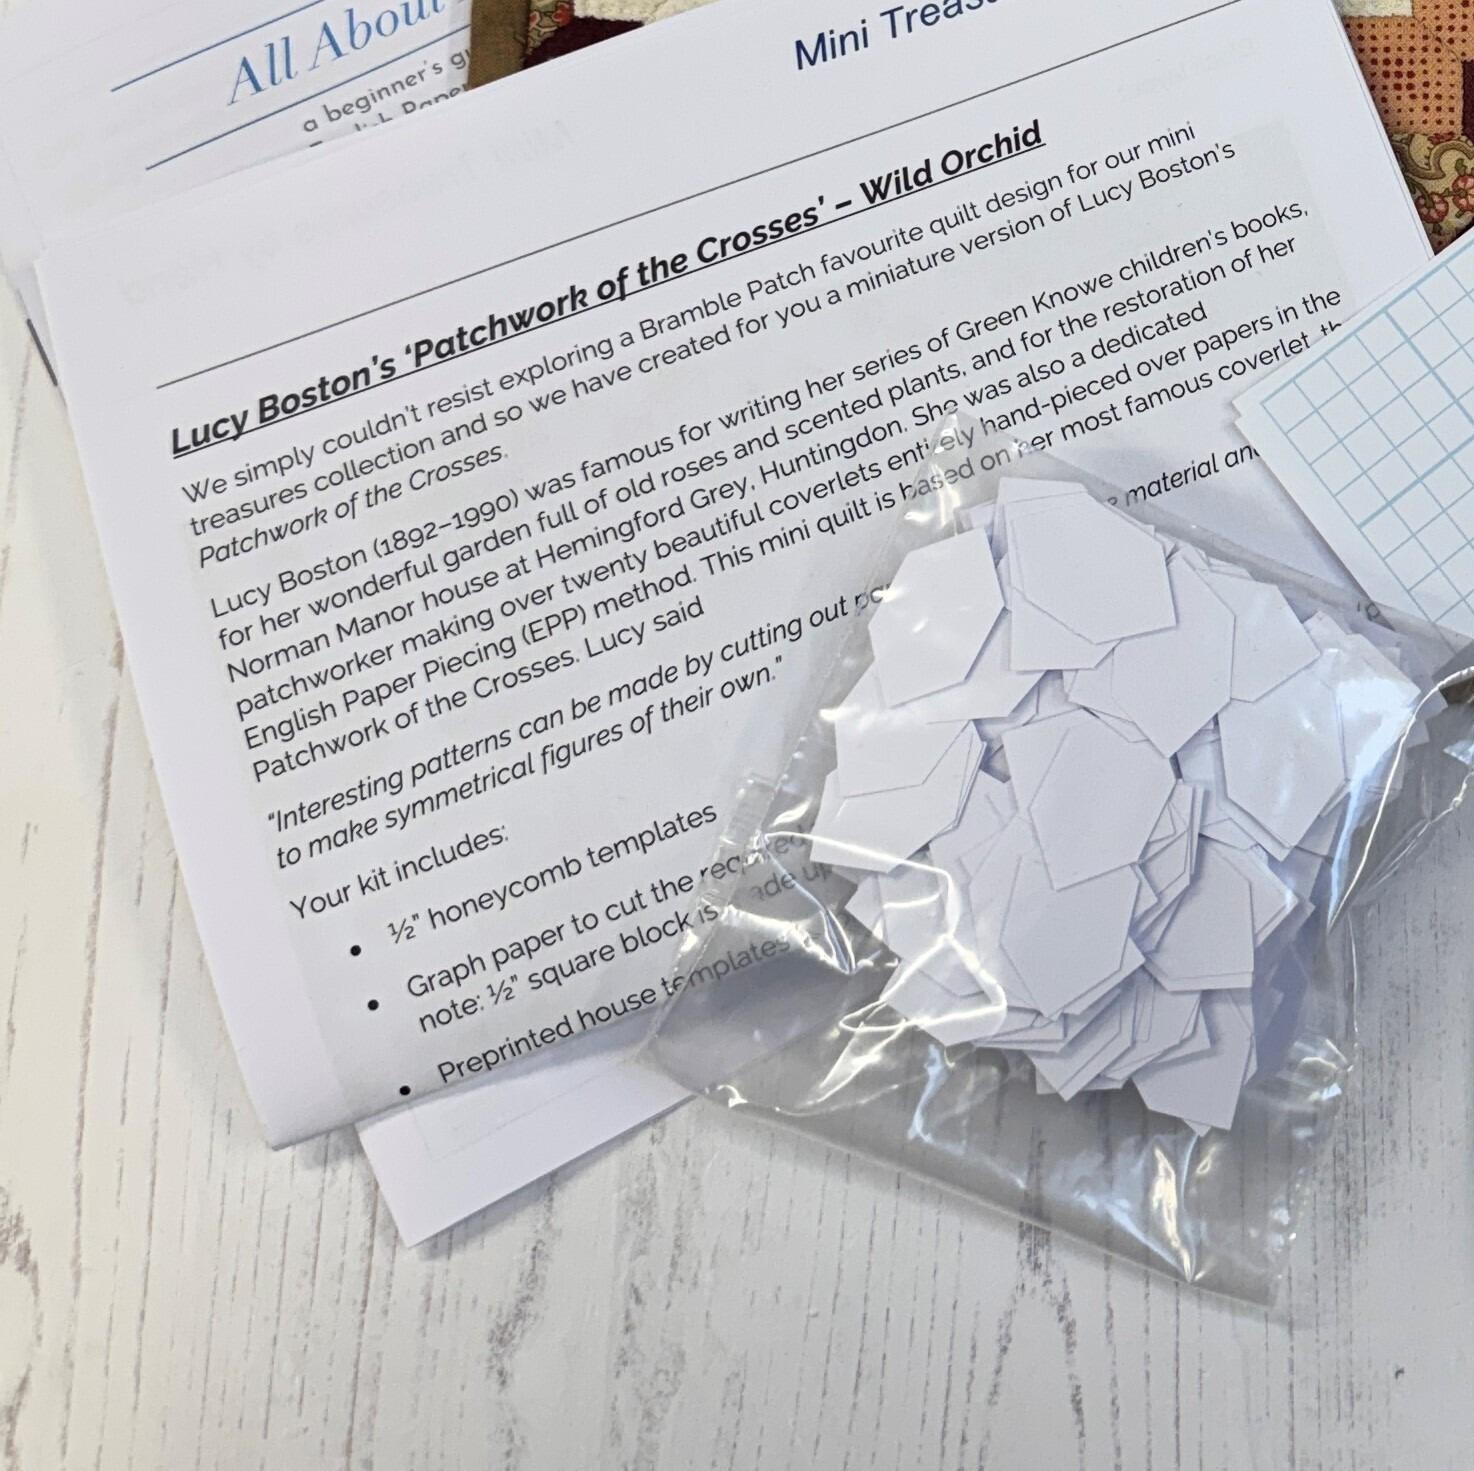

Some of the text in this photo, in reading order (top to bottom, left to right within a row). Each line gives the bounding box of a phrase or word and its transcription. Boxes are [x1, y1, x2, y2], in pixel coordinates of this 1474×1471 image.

[226, 35, 300, 107] All
[302, 118, 319, 133] a
[794, 18, 869, 71] Mini
[170, 407, 249, 457] Lucy
[596, 265, 631, 303] of
[636, 254, 690, 289] the
[858, 158, 935, 206] Wild
[938, 117, 1045, 178] Orchid
[181, 477, 228, 504] We
[233, 444, 315, 487] simply
[426, 377, 495, 418] resist
[498, 337, 615, 391] exploring
[638, 292, 742, 341] Bramble
[746, 263, 817, 301] Patch
[819, 226, 924, 275] favourite
[929, 201, 982, 236] quilt
[985, 175, 1064, 214] design
[1066, 160, 1098, 184] for
[1104, 144, 1141, 170] our
[1147, 120, 1196, 155] mini
[189, 482, 308, 537] treasures
[313, 436, 436, 492] collection
[440, 412, 489, 447] and
[570, 365, 633, 399] have
[637, 323, 732, 374] created
[774, 295, 823, 330] you
[845, 247, 956, 299] miniature
[959, 214, 1046, 255] version
[1076, 179, 1133, 213] Lucy
[210, 582, 271, 619] Lucy
[277, 548, 368, 594] Boston
[523, 472, 577, 501] was
[579, 436, 675, 482] famous
[717, 388, 802, 430] writing
[804, 371, 846, 399] her
[851, 344, 923, 382] series
[955, 304, 1029, 341] Green
[1031, 273, 1114, 315] Knowe
[1229, 202, 1309, 240] books,
[218, 237, 1296, 651] for wonderful garden full old roses and scented plants, and restoration her
[226, 300, 1208, 684] Norman Manor house at Hemingford Grey, Huntingdon. She was also dedicated
[1124, 452, 1221, 508] material
[199, 445, 509, 569] Patchwork Crosses.
[235, 315, 1274, 723] patchworker making over twenty beautiful coverlets entiely hand-pieced over papers
[243, 700, 338, 751] English
[341, 671, 417, 713] Paper
[422, 635, 517, 683] Piecing
[521, 603, 587, 646] (EPP)
[592, 563, 697, 620] method.
[698, 544, 754, 576] This
[758, 518, 811, 557] mini
[816, 497, 873, 536] quilt
[1060, 403, 1123, 442] most
[1124, 372, 1214, 417] famous
[252, 594, 705, 784] Patchwork Crosses. Lucy said
[276, 846, 302, 870] to
[308, 817, 379, 859] make
[384, 751, 536, 831] symmetrical
[540, 723, 624, 776] figures
[660, 685, 715, 723] their
[410, 729, 513, 789] patterns
[518, 709, 564, 740] can
[570, 695, 602, 721] be
[608, 664, 679, 707] made
[684, 650, 714, 677] by
[719, 617, 803, 663] cutting
[809, 595, 849, 628] out
[288, 824, 509, 920] Your kit includes:
[406, 875, 694, 998] Graph paper to cut the
[427, 855, 583, 930] honeycomb
[586, 805, 718, 868] templates
[418, 994, 485, 1033] note:
[527, 944, 616, 991] square
[618, 910, 695, 955] block
[698, 904, 719, 924] is
[436, 937, 791, 1084] Preprinted house templates
